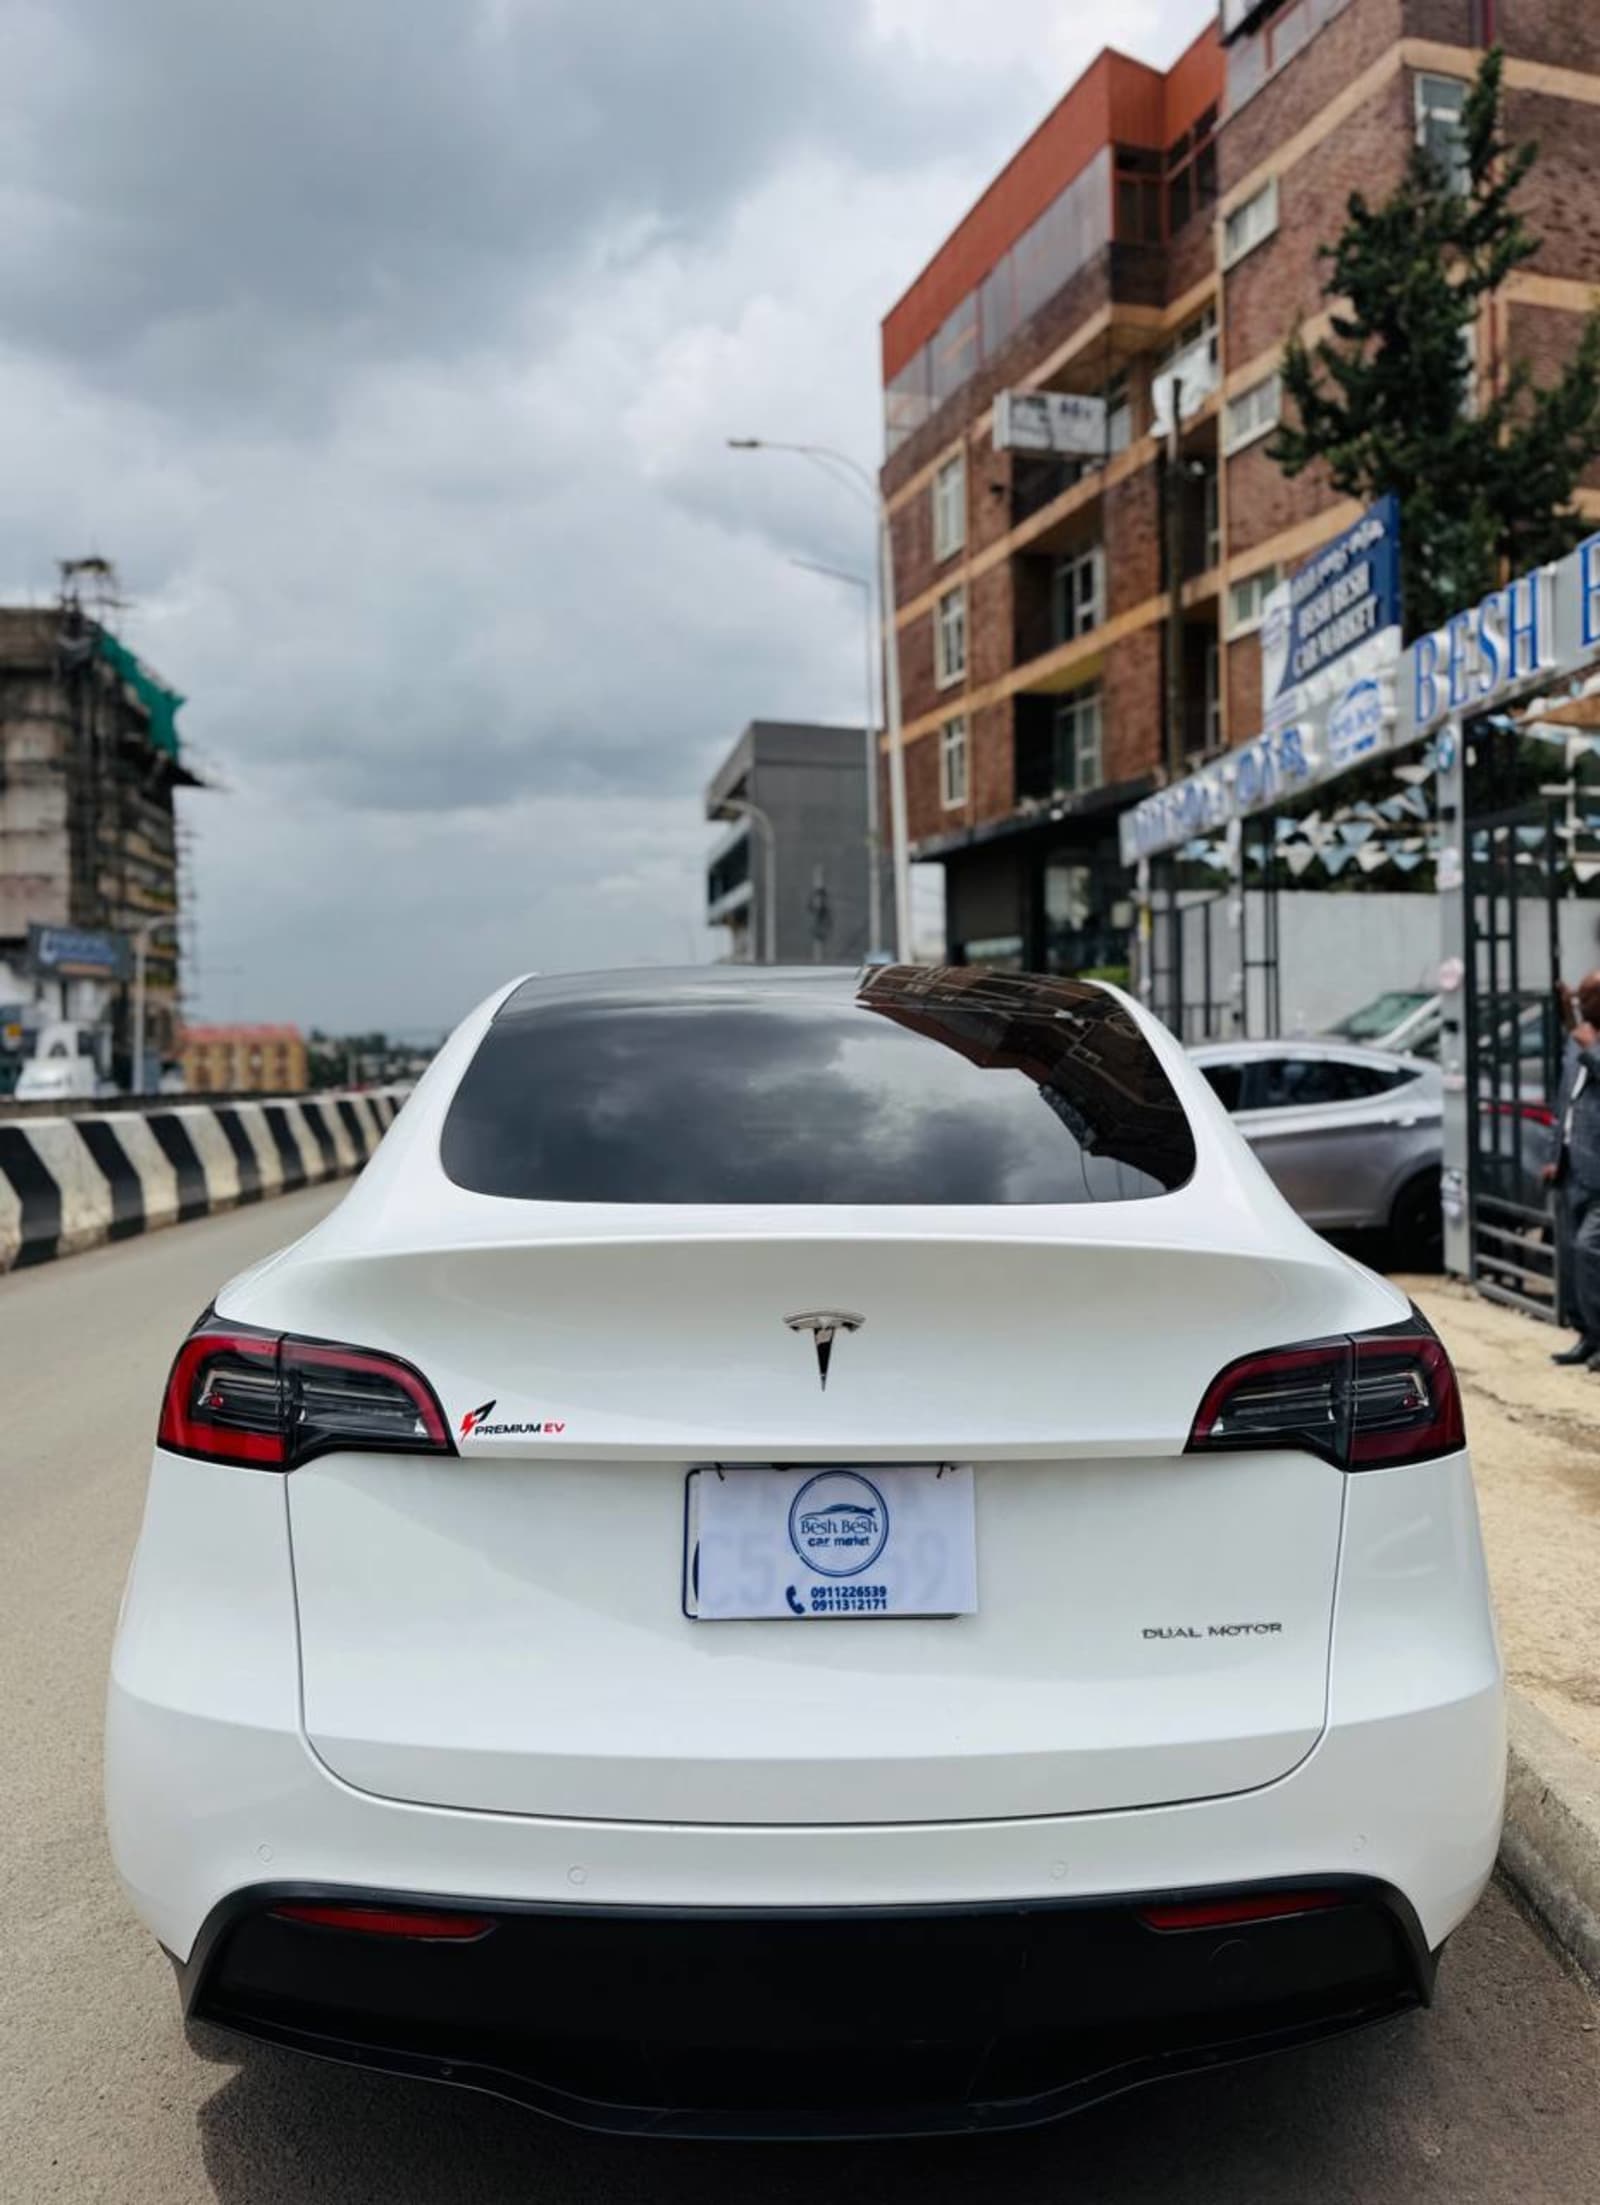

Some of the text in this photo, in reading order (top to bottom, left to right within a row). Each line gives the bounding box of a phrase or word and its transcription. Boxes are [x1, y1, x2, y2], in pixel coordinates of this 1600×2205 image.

[1414, 568, 1542, 724] BESH
[474, 1423, 566, 1436] PREMIUM EV
[800, 1517, 879, 1535] Besh Besh
[807, 1537, 831, 1547] car
[810, 1585, 888, 1599] 0911226539
[811, 1598, 888, 1612] 0911312171
[1142, 1622, 1283, 1640] DUAL MOTOR
